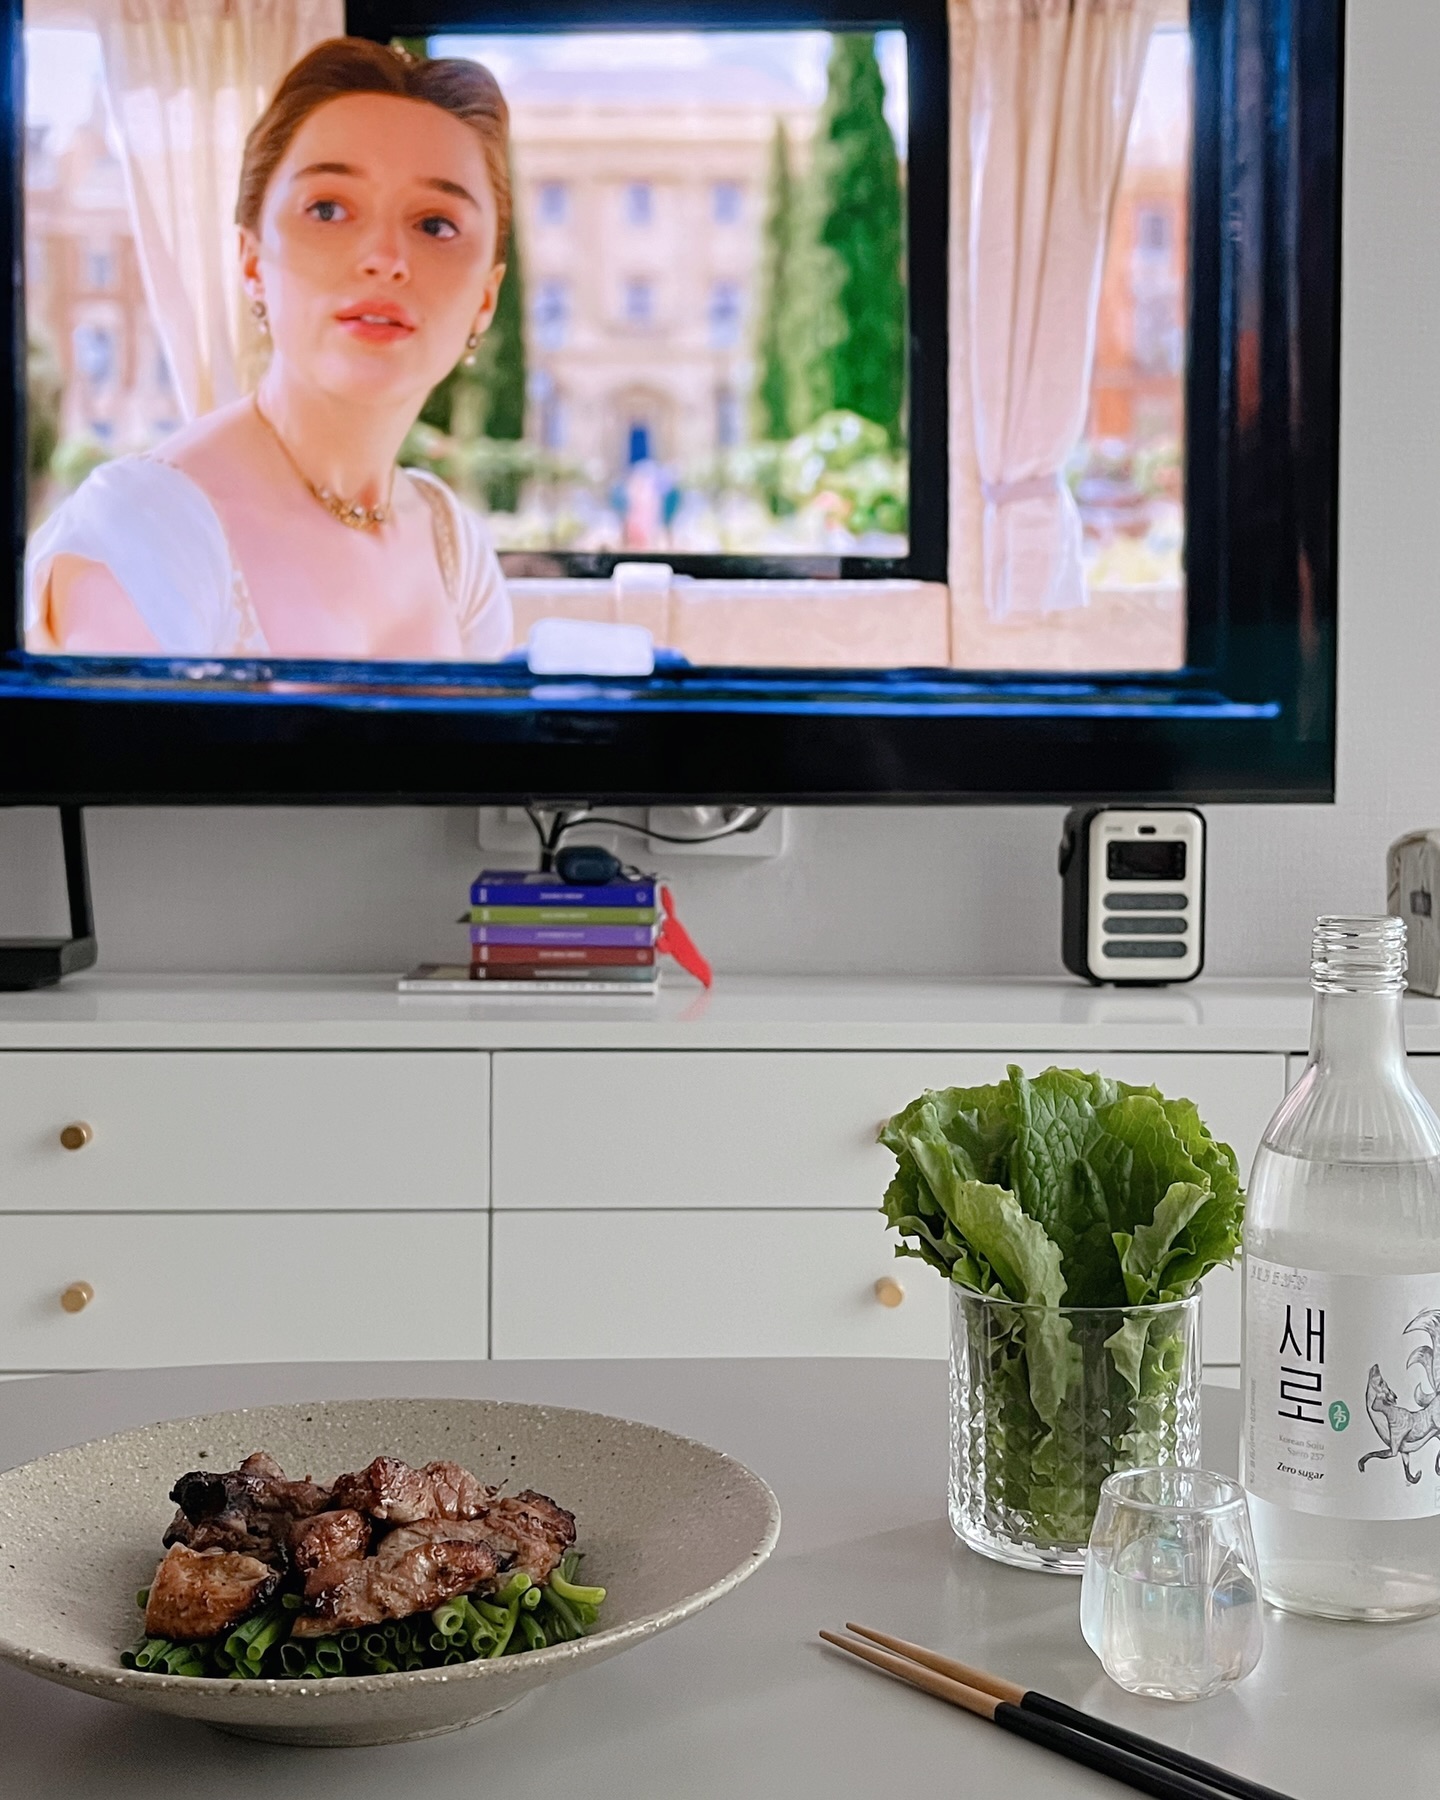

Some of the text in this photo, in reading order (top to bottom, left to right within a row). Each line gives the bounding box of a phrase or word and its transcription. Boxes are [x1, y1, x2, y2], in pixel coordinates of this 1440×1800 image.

[1278, 1304, 1325, 1424] 새로
[1278, 1434, 1325, 1451] Korean Soju
[1287, 1446, 1325, 1461] Saero 257
[1276, 1461, 1325, 1481] Zero sugar
